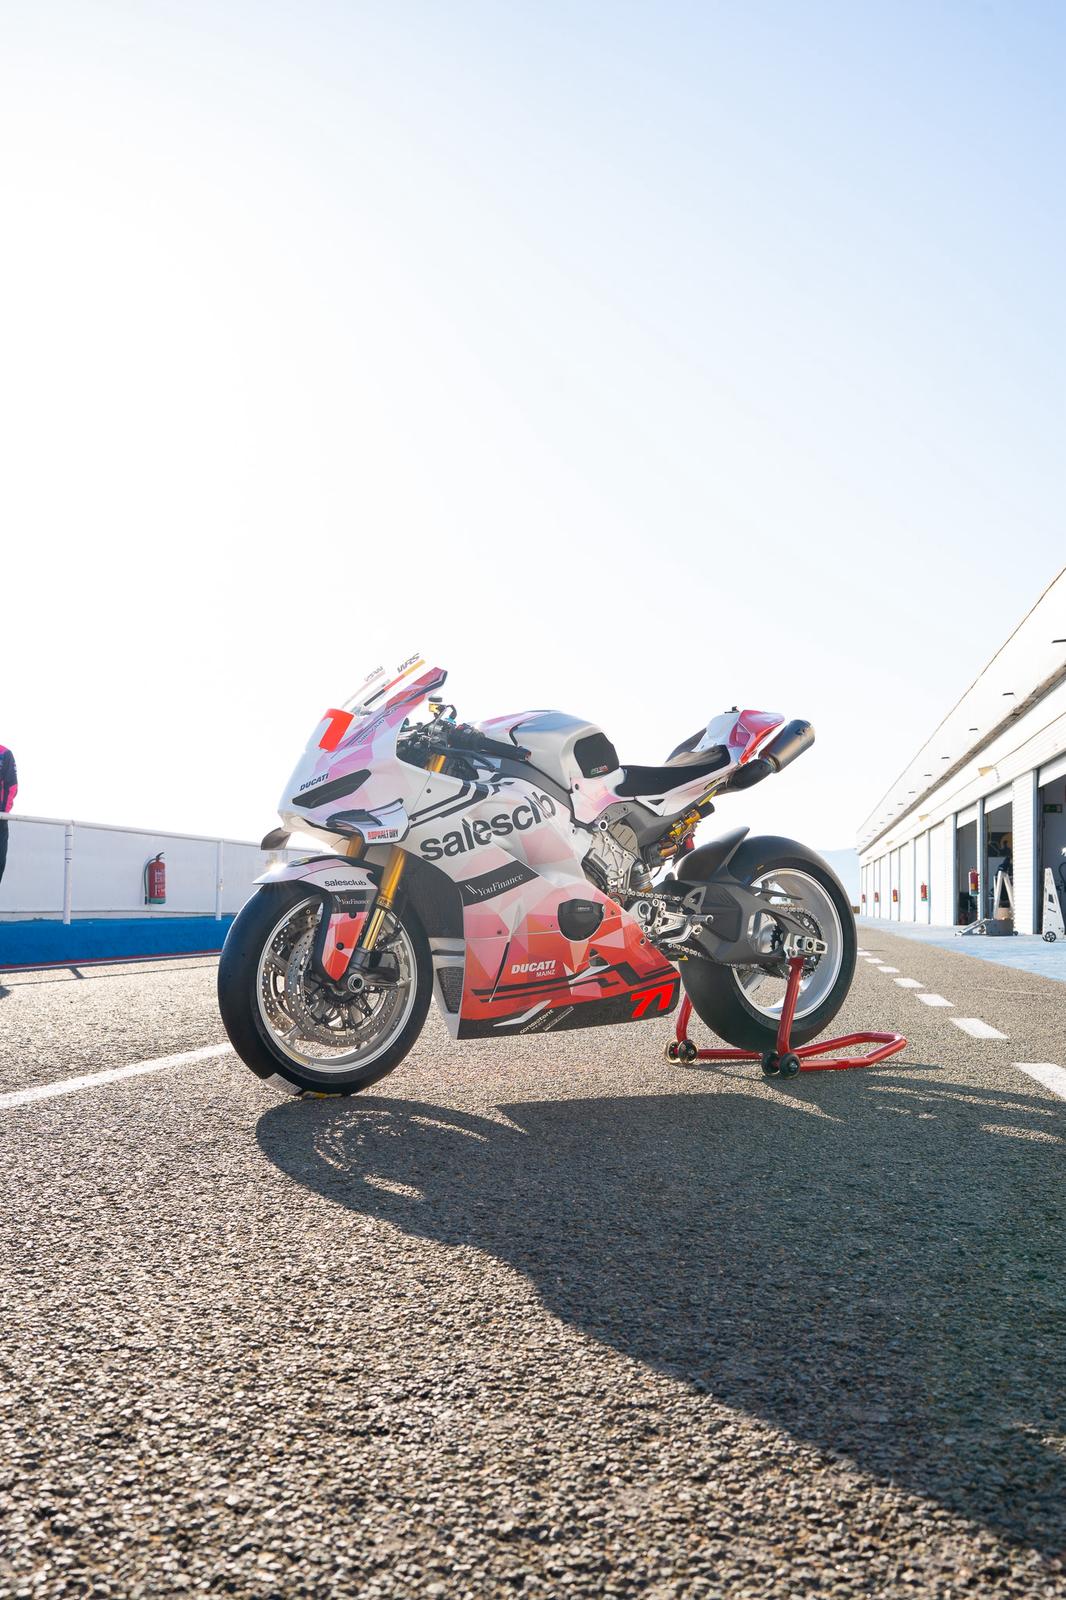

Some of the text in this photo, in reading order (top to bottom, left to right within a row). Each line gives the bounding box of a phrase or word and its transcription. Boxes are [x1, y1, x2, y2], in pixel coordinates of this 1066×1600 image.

[397, 652, 420, 673] WRS
[299, 773, 329, 791] DUCATI
[324, 879, 367, 887] salesclub
[477, 874, 523, 897] YouFinance
[511, 959, 556, 975] DUCATI
[536, 969, 556, 978] MAINZ
[630, 982, 675, 1019] 71
